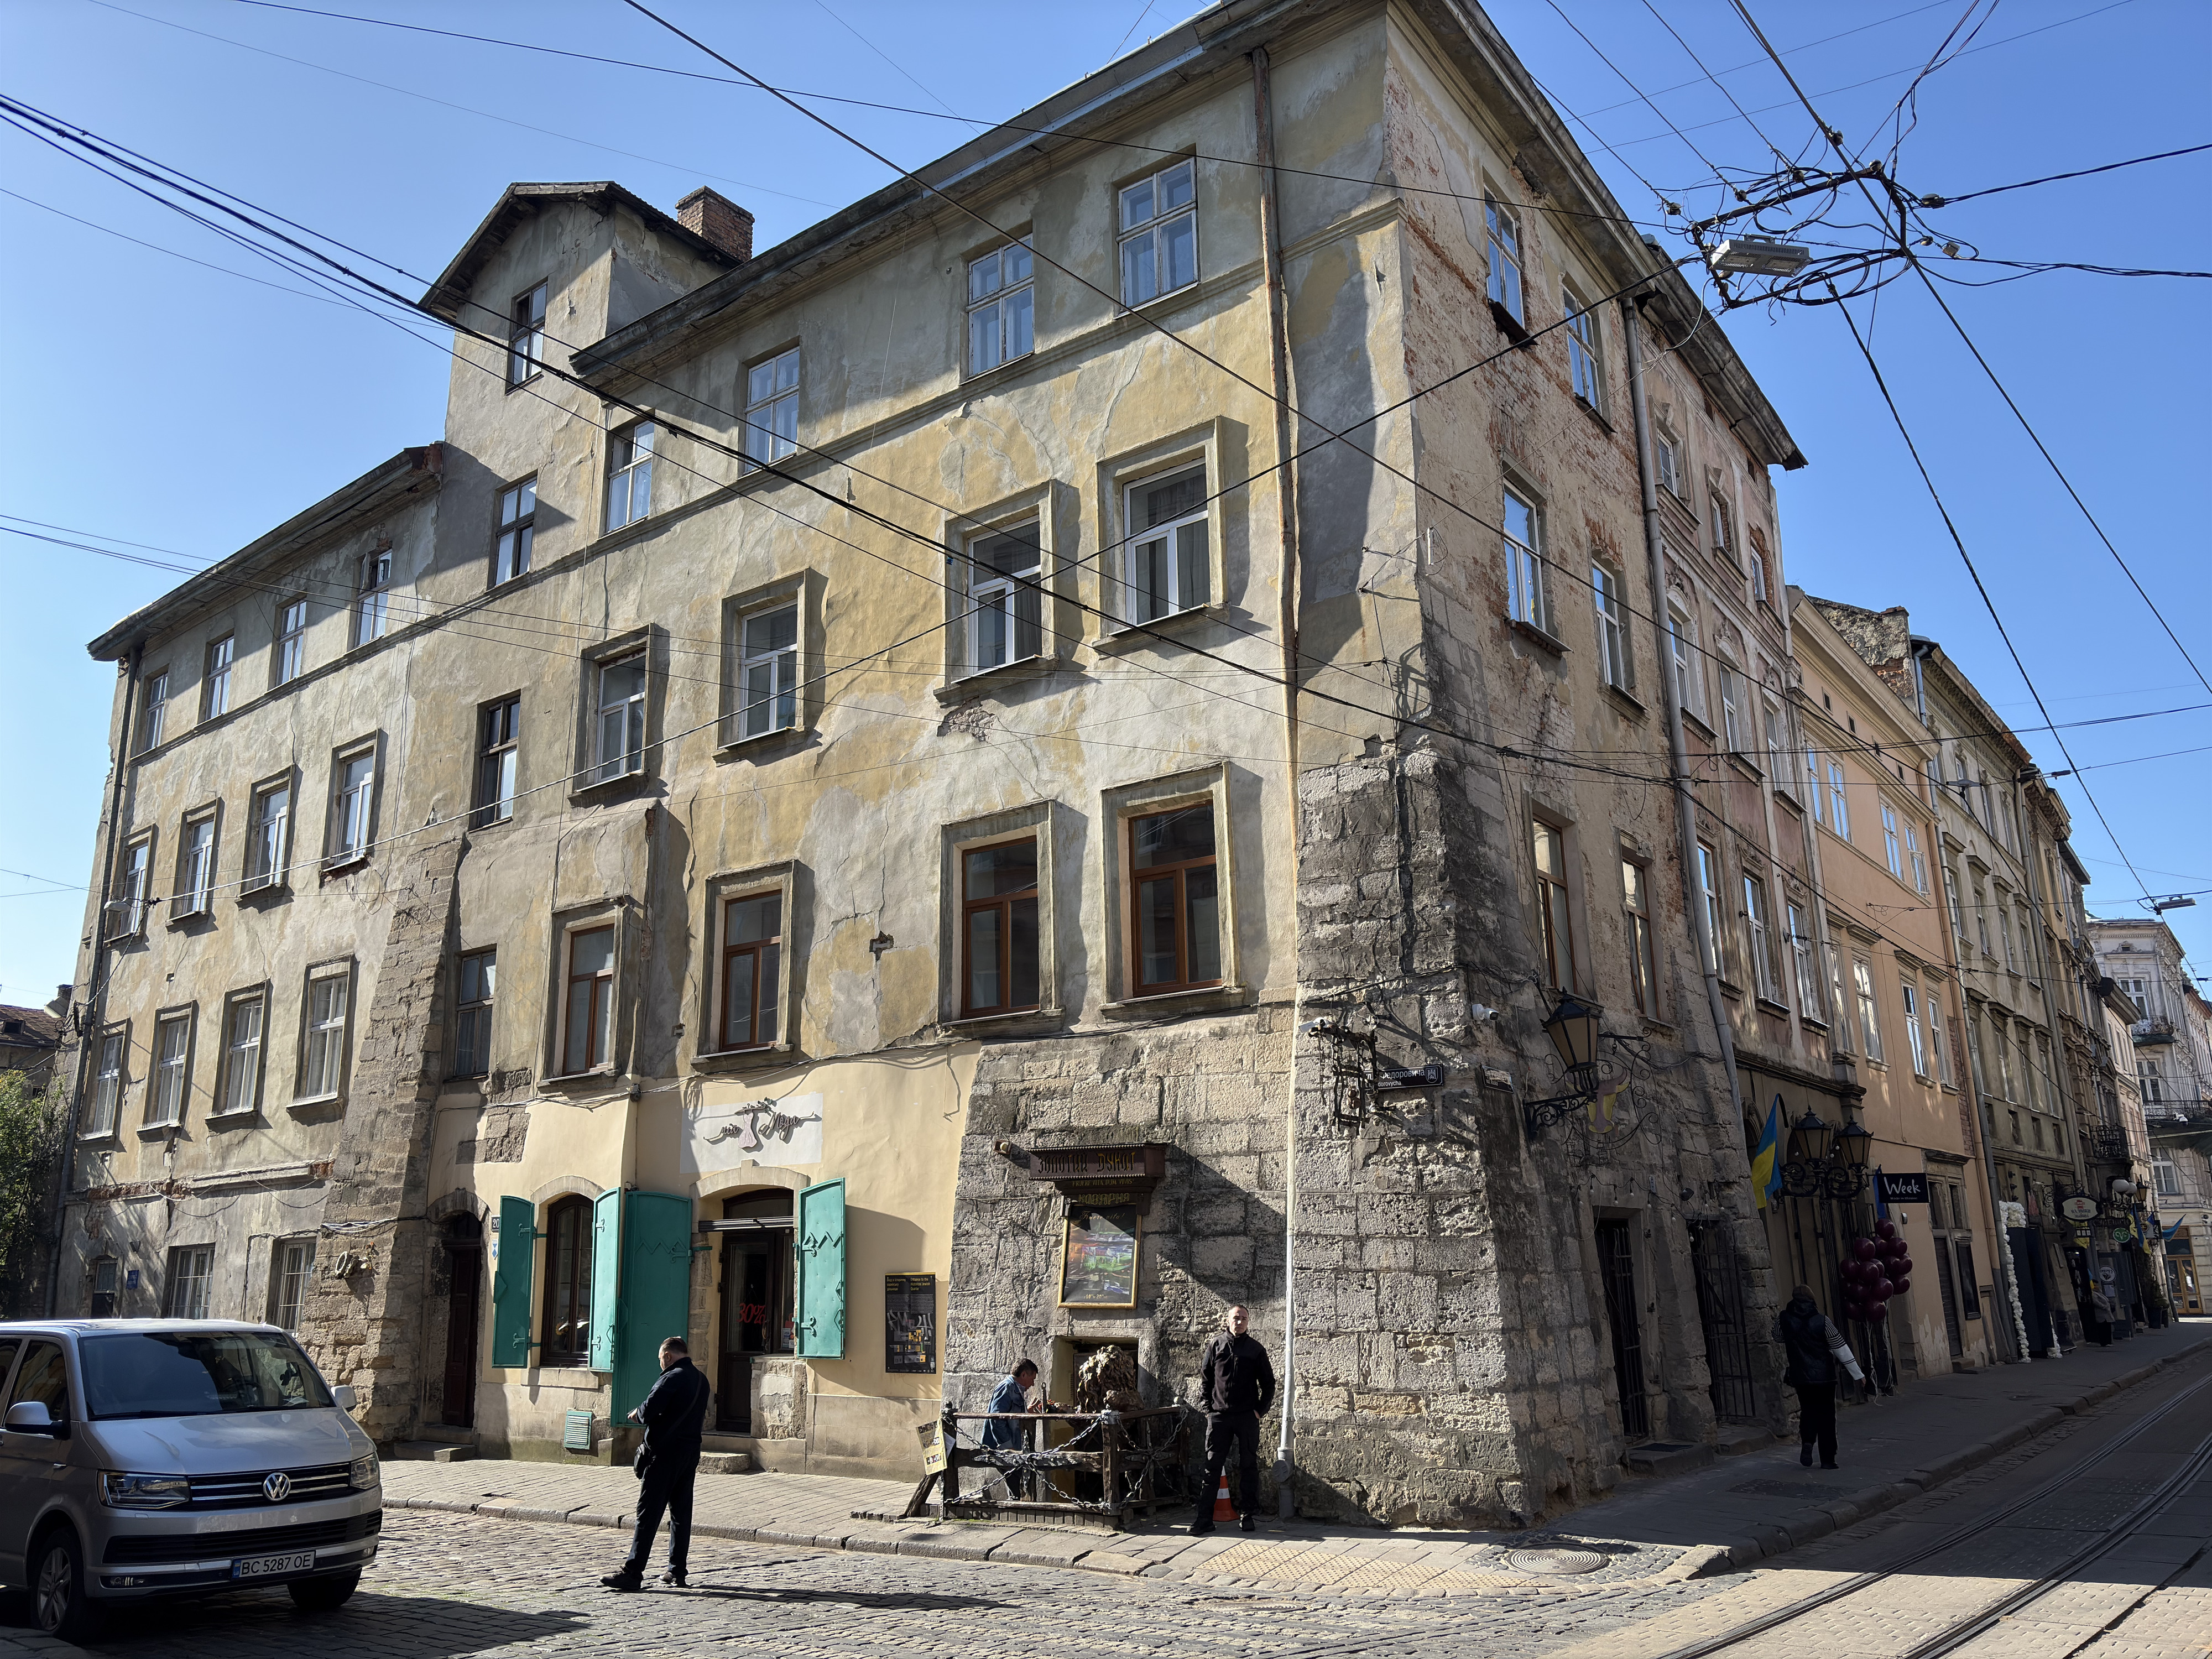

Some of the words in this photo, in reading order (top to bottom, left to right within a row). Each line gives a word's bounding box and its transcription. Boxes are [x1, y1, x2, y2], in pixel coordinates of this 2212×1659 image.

[1097, 1151, 1136, 1172] ДУКАТ
[1884, 1176, 1921, 1195] Week
[492, 1218, 500, 1228] 20
[736, 1302, 766, 1325] 30%
[242, 1561, 260, 1575] BC
[263, 1557, 291, 1573] 5287
[294, 1554, 311, 1569] OE
